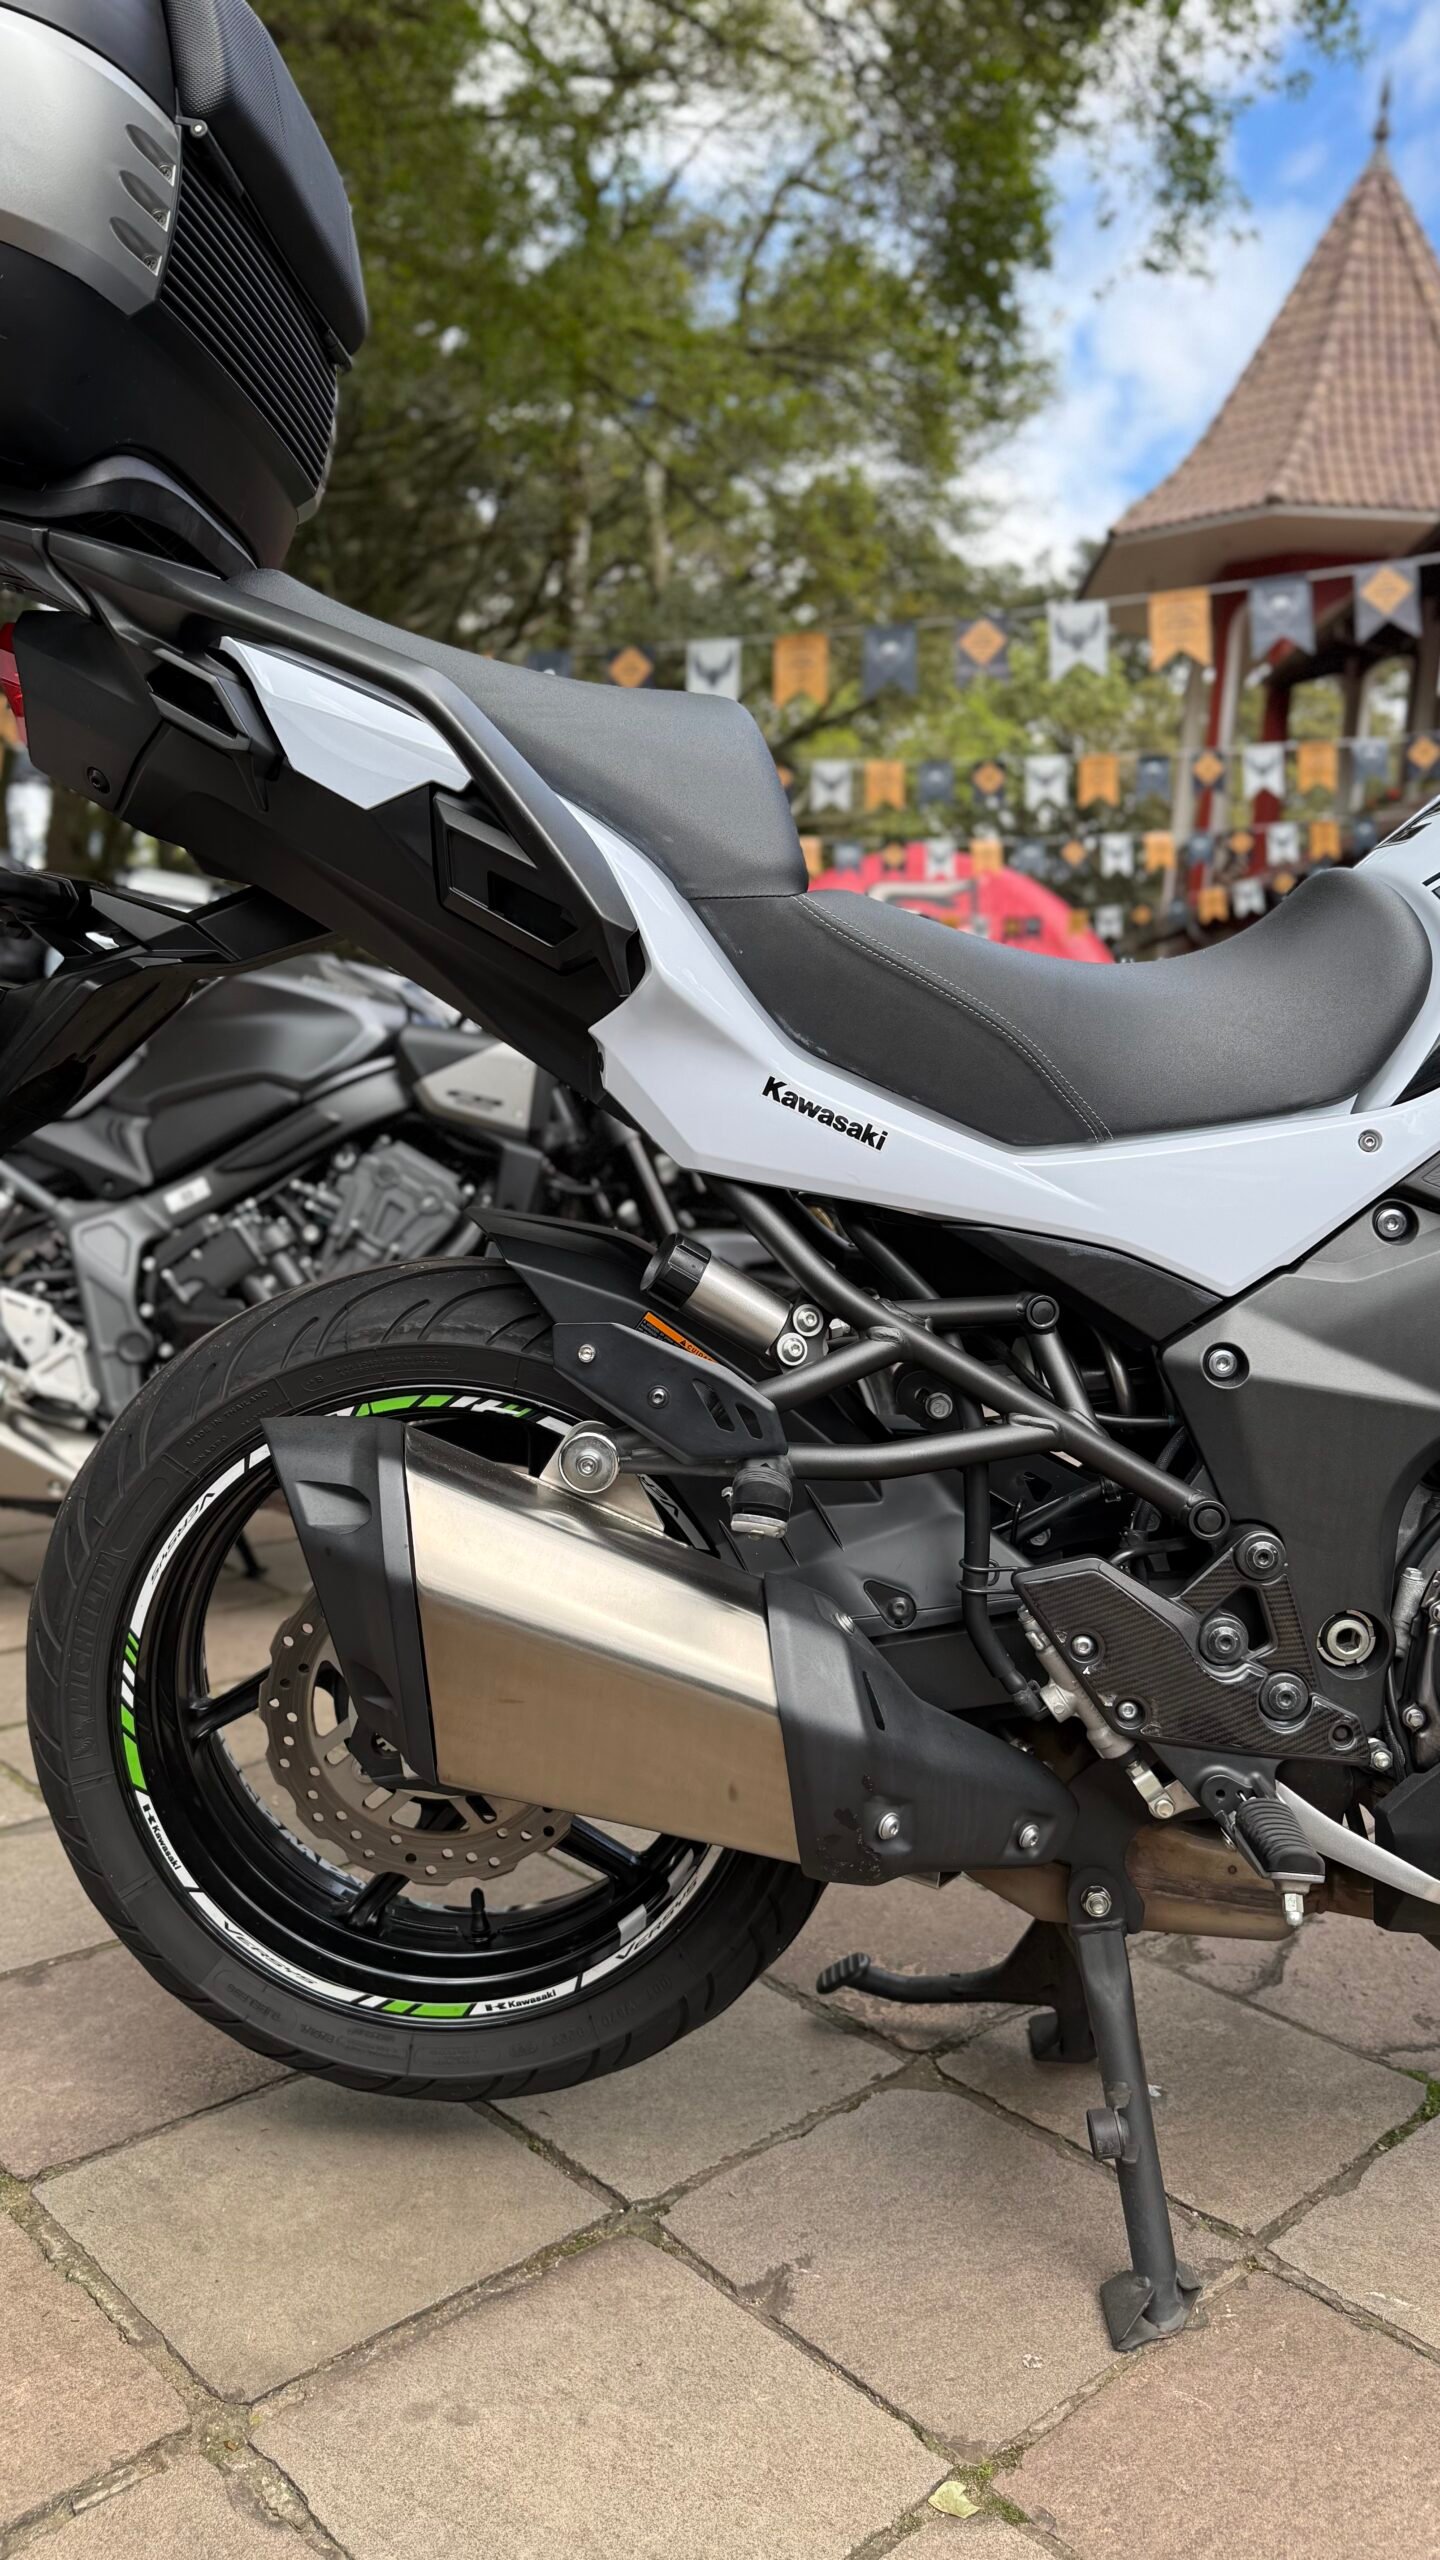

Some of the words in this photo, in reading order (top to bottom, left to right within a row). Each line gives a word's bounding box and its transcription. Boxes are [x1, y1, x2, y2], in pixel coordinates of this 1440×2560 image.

[762, 1076, 888, 1150] Kawasaki
[152, 1825, 182, 1870] Kawasaki
[508, 1989, 556, 2008] Kawasaki
